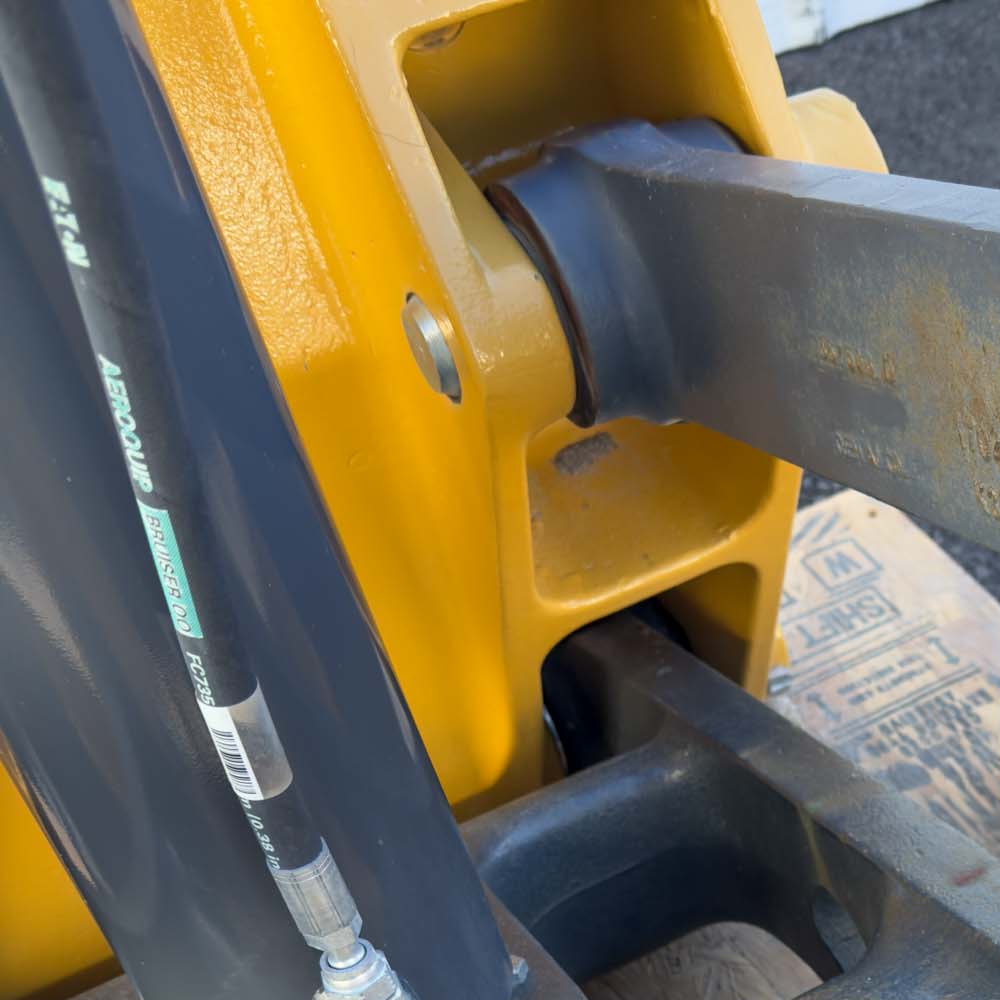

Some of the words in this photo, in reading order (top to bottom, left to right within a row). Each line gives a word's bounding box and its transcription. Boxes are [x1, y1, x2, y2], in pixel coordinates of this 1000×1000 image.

[98, 353, 153, 493] AEROQUIP
[145, 514, 182, 599] BRUISER
[186, 651, 216, 706] FC735
[797, 596, 884, 647] SHIFT
